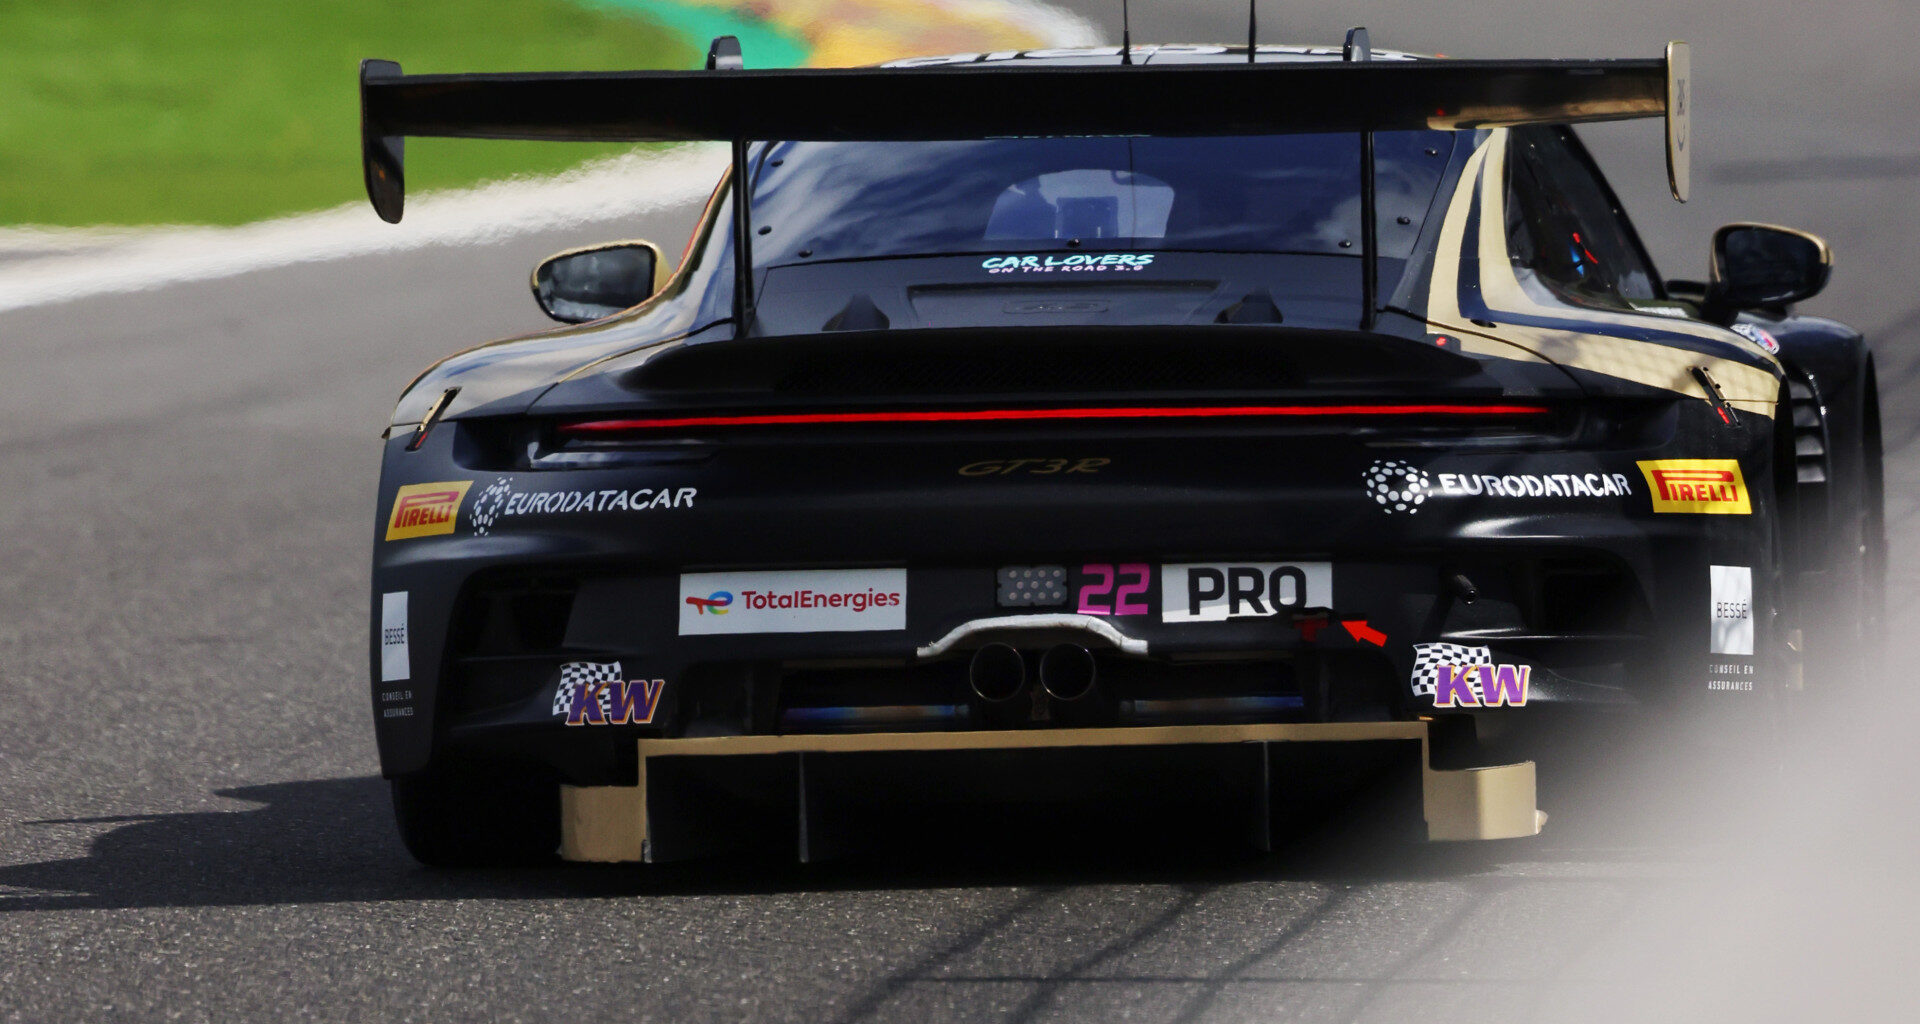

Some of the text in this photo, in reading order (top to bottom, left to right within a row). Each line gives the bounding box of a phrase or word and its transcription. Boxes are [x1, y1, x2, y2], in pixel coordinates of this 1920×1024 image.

[982, 254, 1155, 269] CAR LOVERS
[1438, 473, 1633, 498] EURODATACAR
[1651, 469, 1739, 502] PIRELLI
[393, 490, 460, 529] PIRELLI
[504, 486, 698, 516] EURODATACAR
[742, 587, 901, 612] TotalEnergies
[1077, 563, 1151, 616] 22
[1187, 566, 1307, 616] PRO
[1716, 599, 1748, 619] BESSÉ
[384, 623, 405, 646] BESSÉ
[1709, 664, 1754, 675] CONSEIL EN
[1434, 663, 1531, 708] KW
[1708, 681, 1753, 691] ASSURANCES
[566, 678, 666, 726] KW
